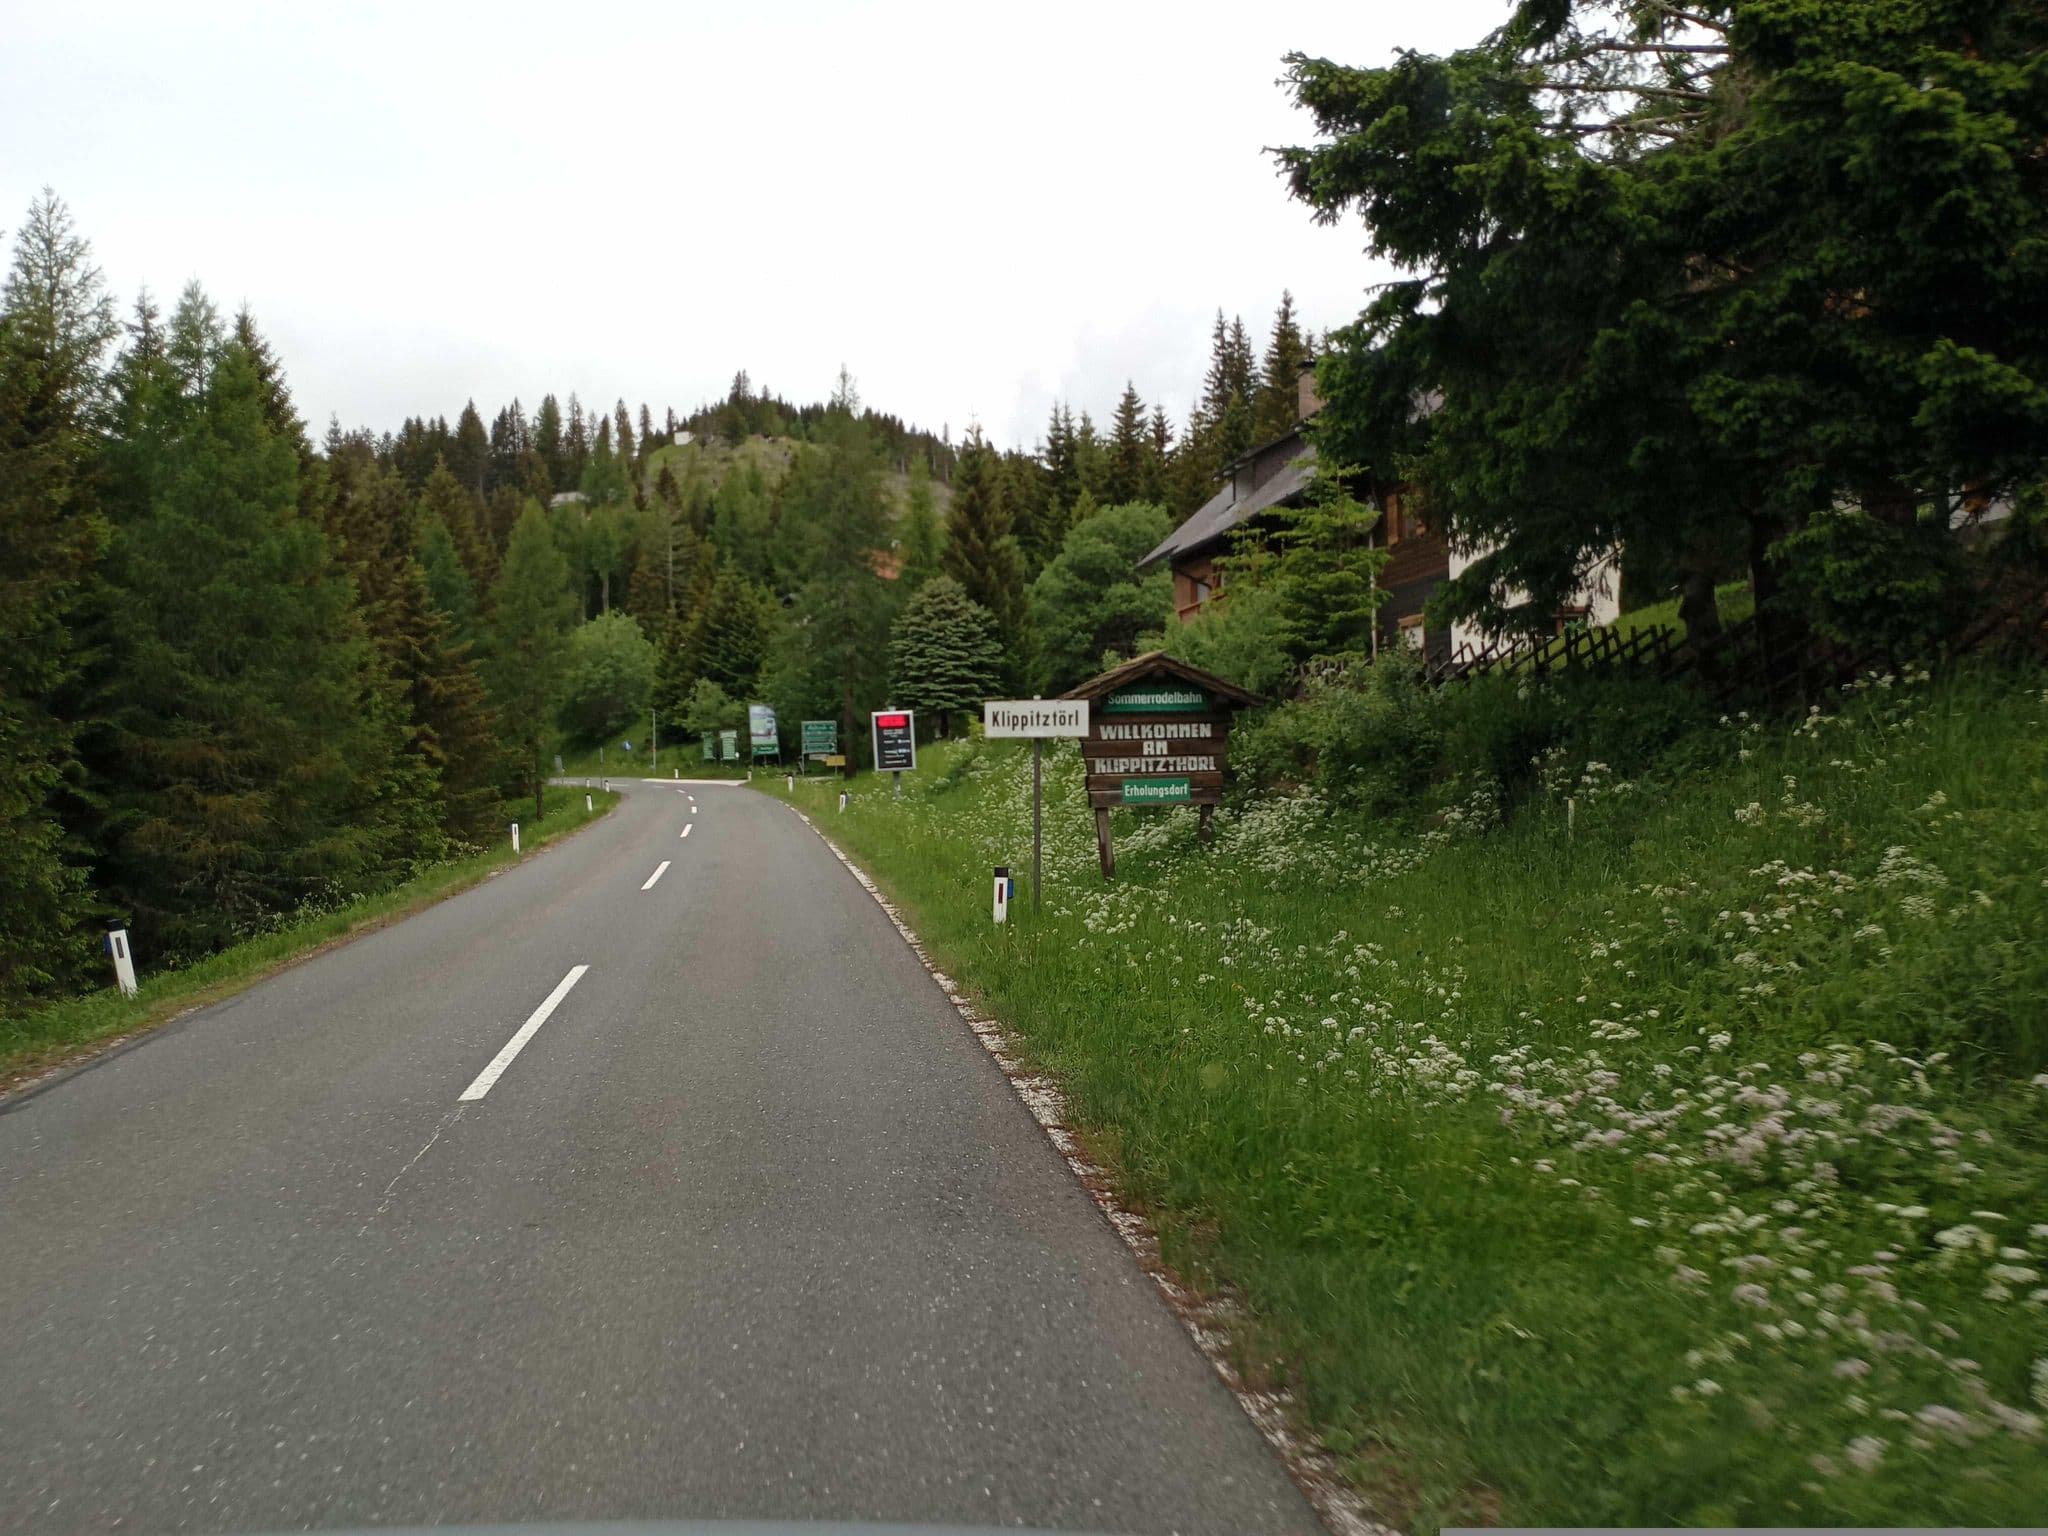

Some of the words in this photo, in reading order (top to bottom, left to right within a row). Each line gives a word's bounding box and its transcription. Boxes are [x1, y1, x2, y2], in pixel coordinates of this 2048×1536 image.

[1108, 691, 1202, 705] Sommerrodelbahn
[992, 710, 1079, 731] Klippitztörl
[1100, 724, 1212, 740] WILLKOMMEN
[1125, 783, 1187, 798] Erholungsdorf
